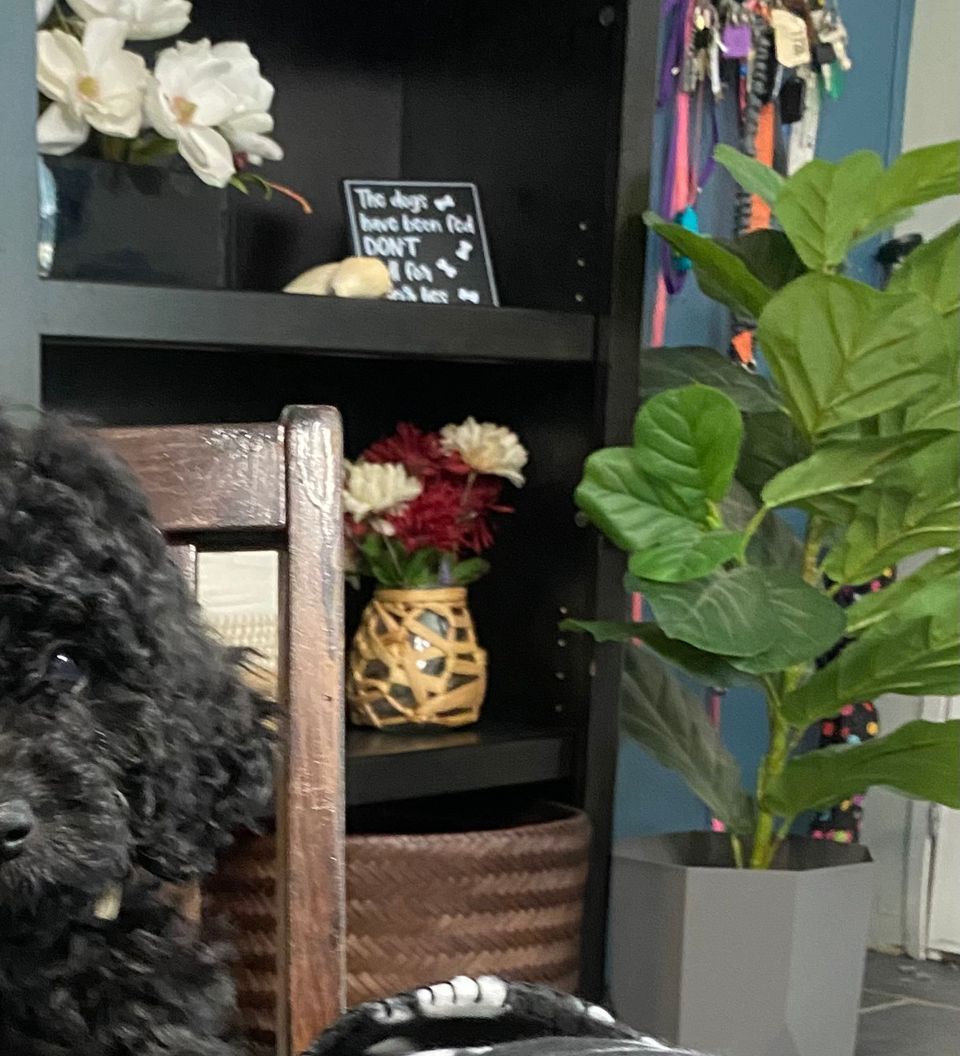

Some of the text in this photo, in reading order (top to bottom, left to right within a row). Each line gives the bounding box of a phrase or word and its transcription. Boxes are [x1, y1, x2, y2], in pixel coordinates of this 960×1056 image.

[353, 188, 429, 214] The dogs
[358, 212, 399, 233] have
[401, 213, 443, 233] been
